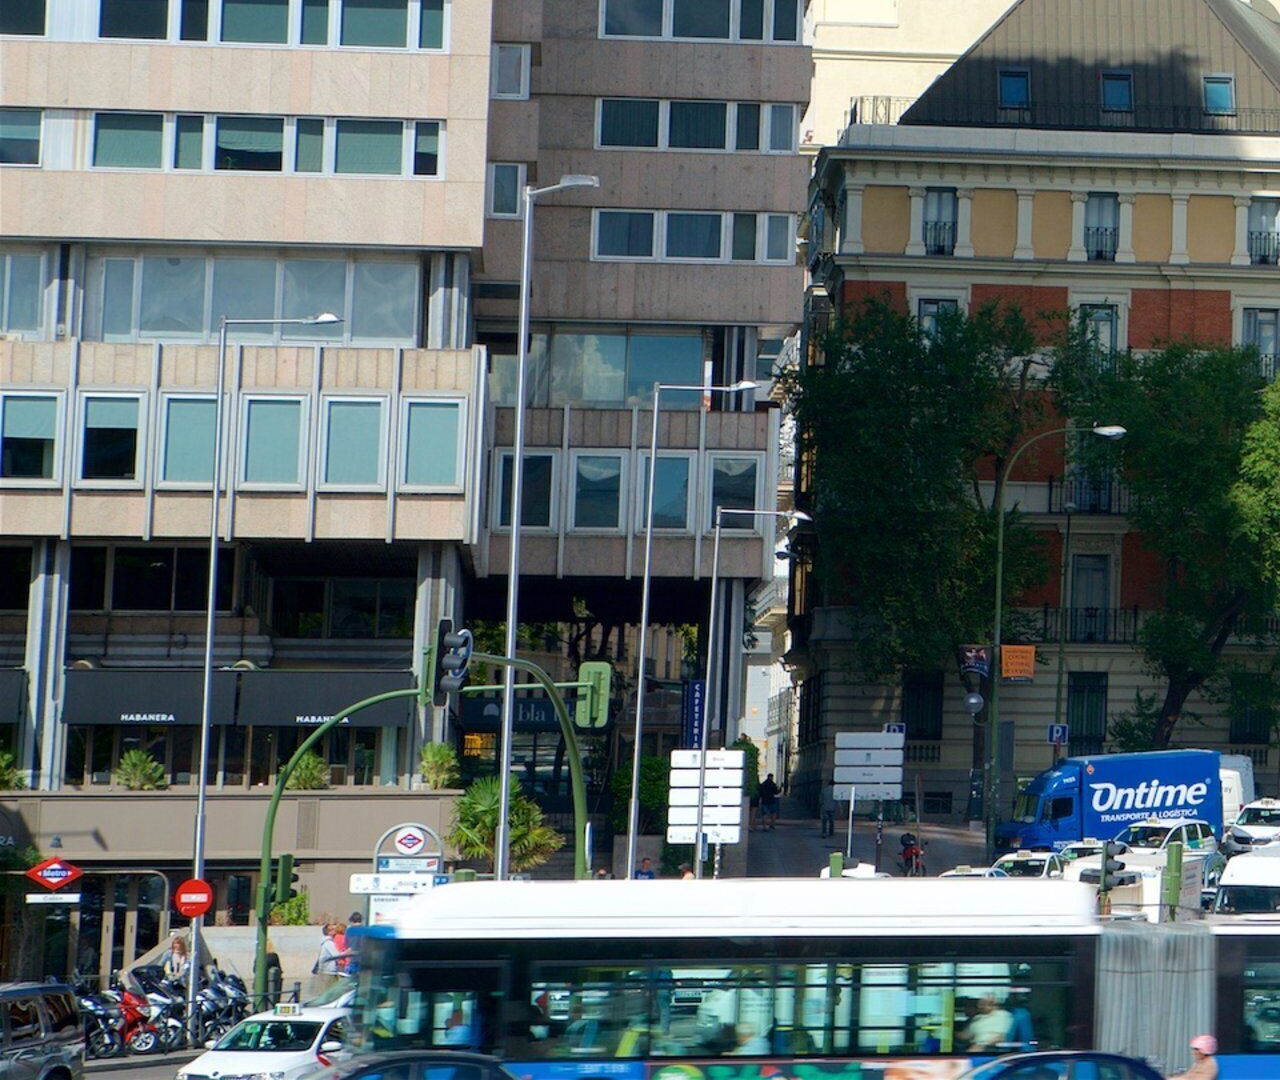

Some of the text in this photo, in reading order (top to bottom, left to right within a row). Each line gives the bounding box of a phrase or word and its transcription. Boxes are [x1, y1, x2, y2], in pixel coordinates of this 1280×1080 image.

[121, 713, 175, 722] HABANERA
[296, 715, 349, 724] HABANA
[1089, 779, 1208, 812] Ontime
[1101, 811, 1151, 823] TRANSPORTE
[42, 869, 68, 878] Metro
